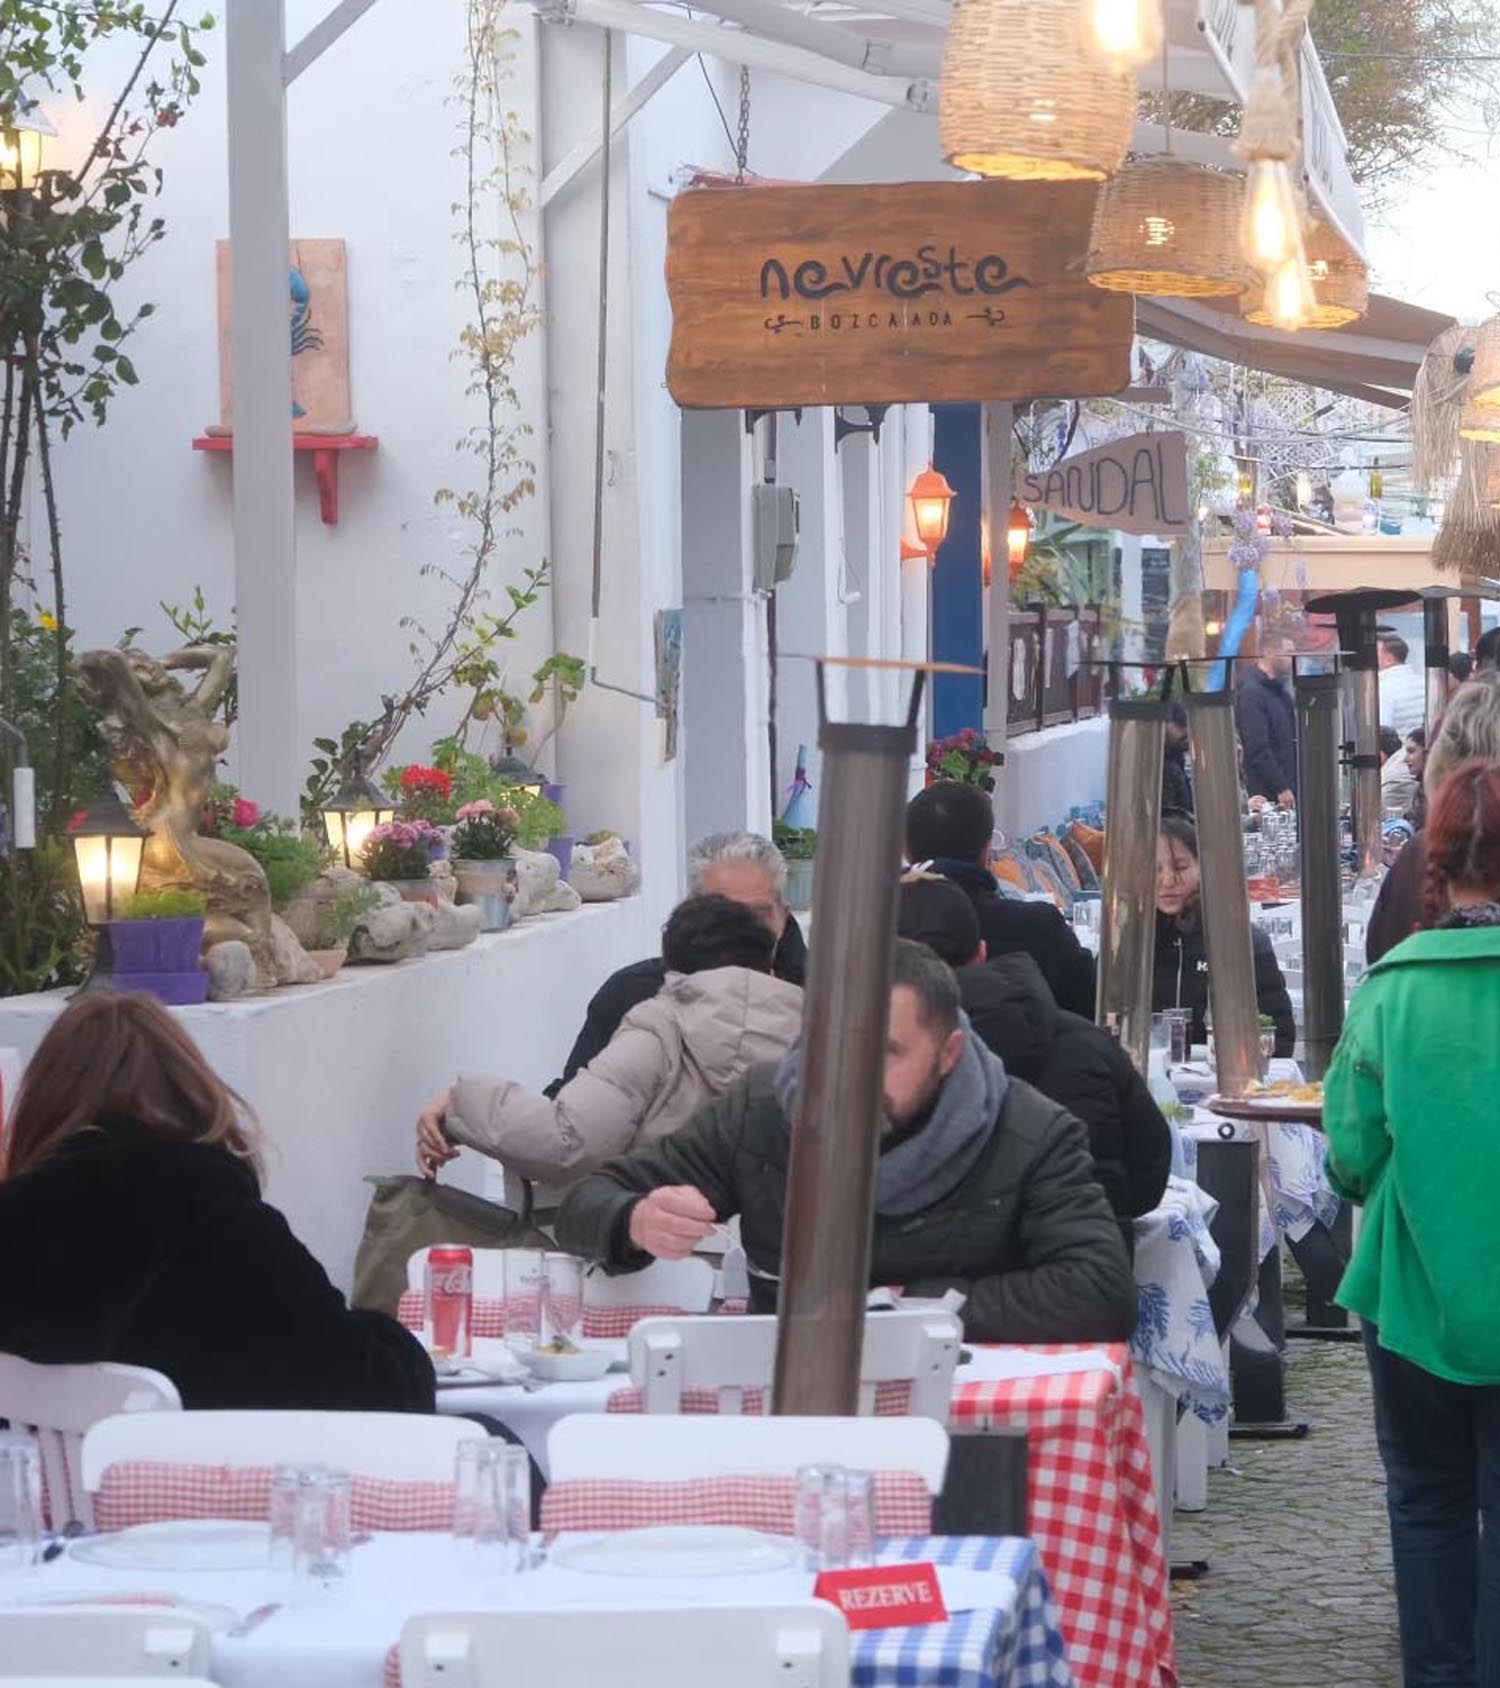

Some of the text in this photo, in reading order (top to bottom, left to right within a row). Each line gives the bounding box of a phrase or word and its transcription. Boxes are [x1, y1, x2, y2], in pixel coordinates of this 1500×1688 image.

[760, 246, 1031, 300] nevreste
[1022, 441, 1185, 525] SANDAL
[838, 1580, 933, 1610] REZERVE
